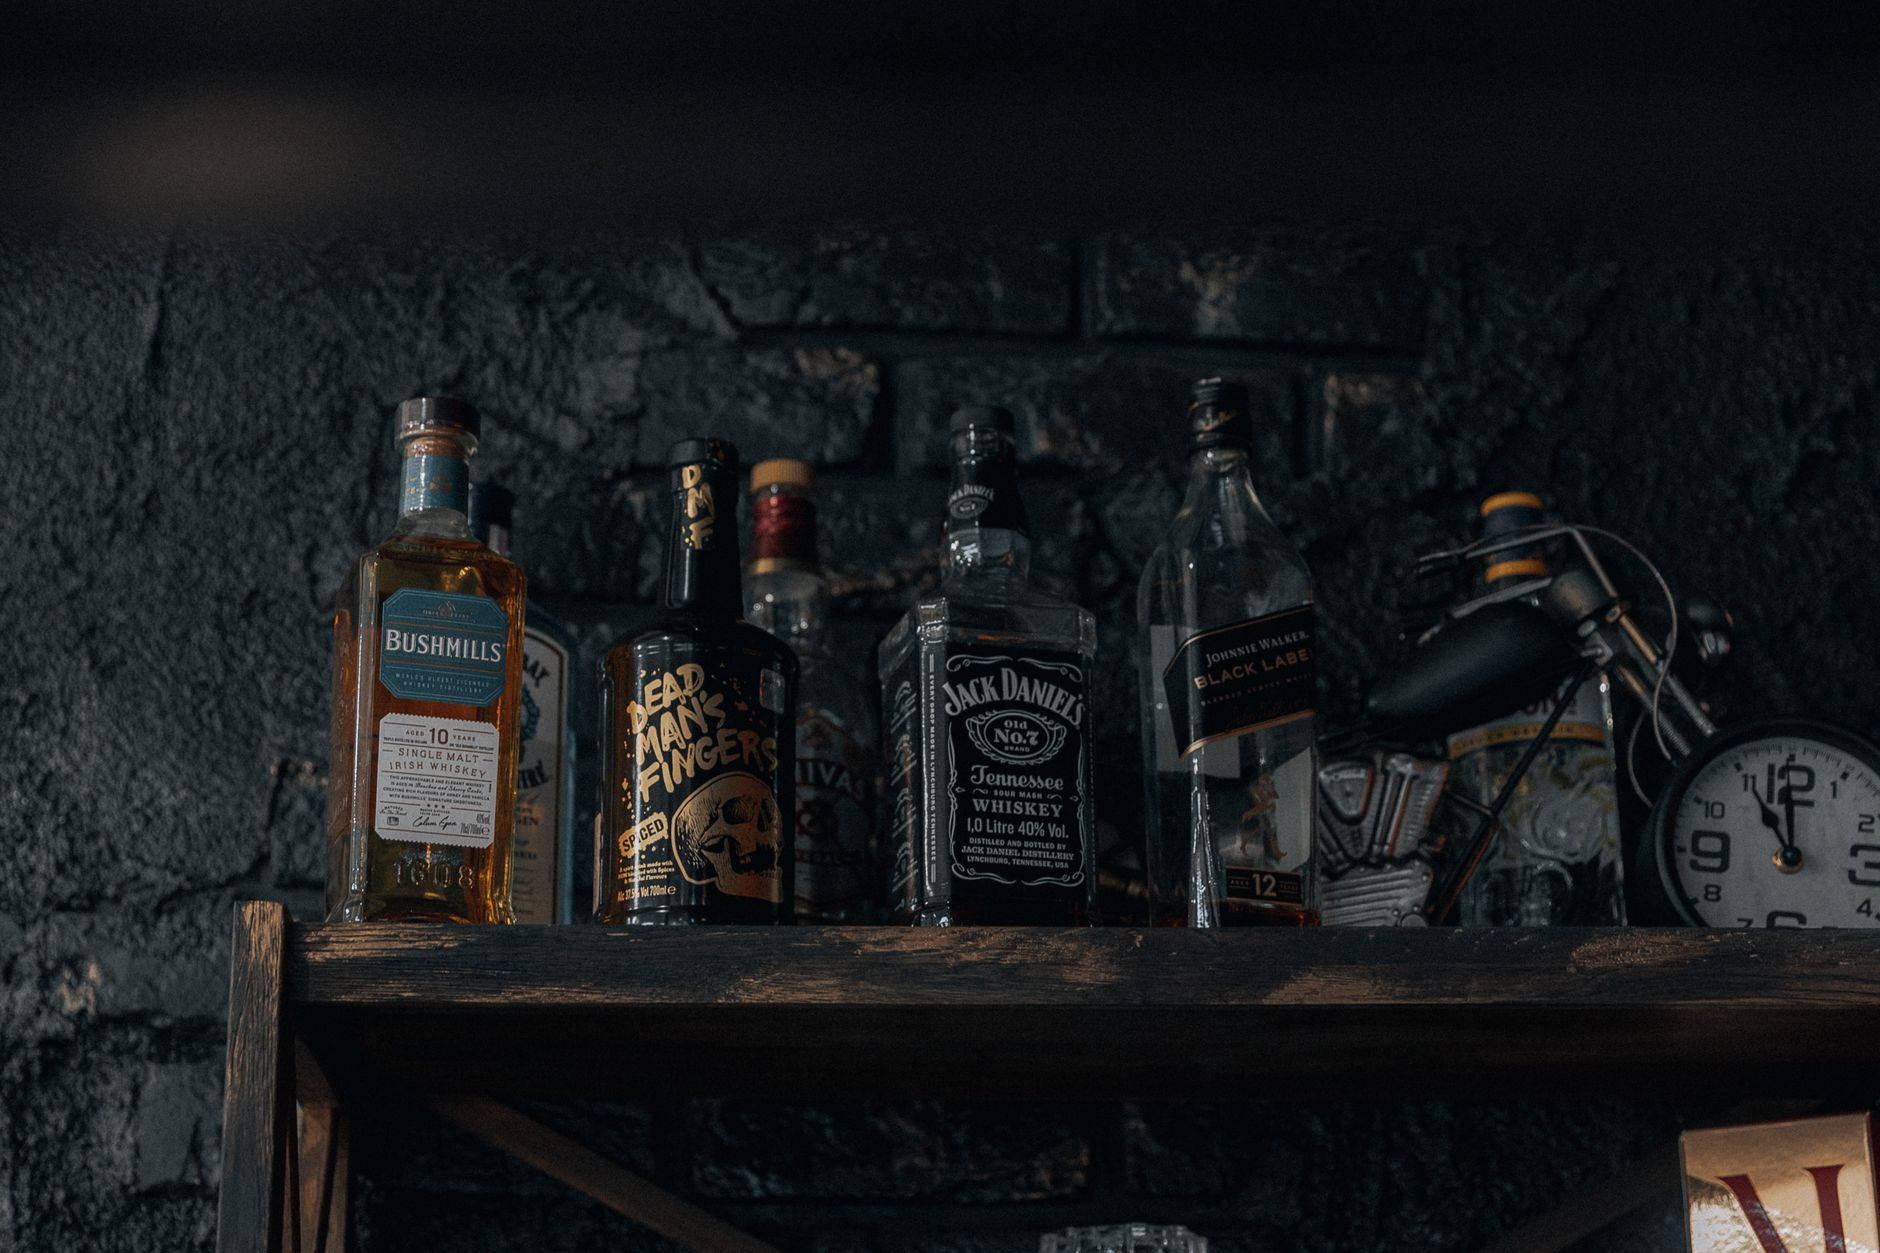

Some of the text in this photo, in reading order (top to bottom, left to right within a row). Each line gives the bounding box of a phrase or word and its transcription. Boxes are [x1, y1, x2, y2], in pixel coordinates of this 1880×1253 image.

[386, 629, 501, 663] BUSHMILLS
[1205, 643, 1259, 668] JOHNNIE
[1193, 661, 1258, 689] BLACK
[626, 663, 705, 735] DEAD
[942, 667, 1086, 730] JACK DANIEL'S
[429, 728, 449, 745] 10
[452, 734, 476, 742] YEARS
[636, 690, 727, 766] MAN'S
[399, 748, 479, 763] SINGLE MALT
[1004, 745, 1030, 753] BRAND
[389, 761, 487, 778] IRISH WHISKEY
[639, 728, 779, 803] FINGERS
[970, 764, 1064, 791] Tennessee
[1766, 762, 1816, 808] 12
[993, 789, 1043, 800] SOUR MASH
[1829, 780, 1839, 799] 1
[971, 798, 1064, 818] WHISKEY
[1703, 801, 1725, 819] 10
[986, 818, 1015, 835] Litre
[1018, 820, 1045, 838] 40%
[1048, 823, 1070, 840] Vol.
[1858, 813, 1875, 833] 2
[961, 845, 1075, 861] JACK DANIEL DISTILLERY
[969, 837, 1067, 851] DISTILLED AND BOTTLED BY
[1689, 830, 1731, 874] 9
[1054, 860, 1070, 869] USA
[1848, 844, 1880, 887] 3
[1251, 872, 1278, 897] 12
[1703, 884, 1721, 902] 8
[1856, 898, 1873, 917] 4
